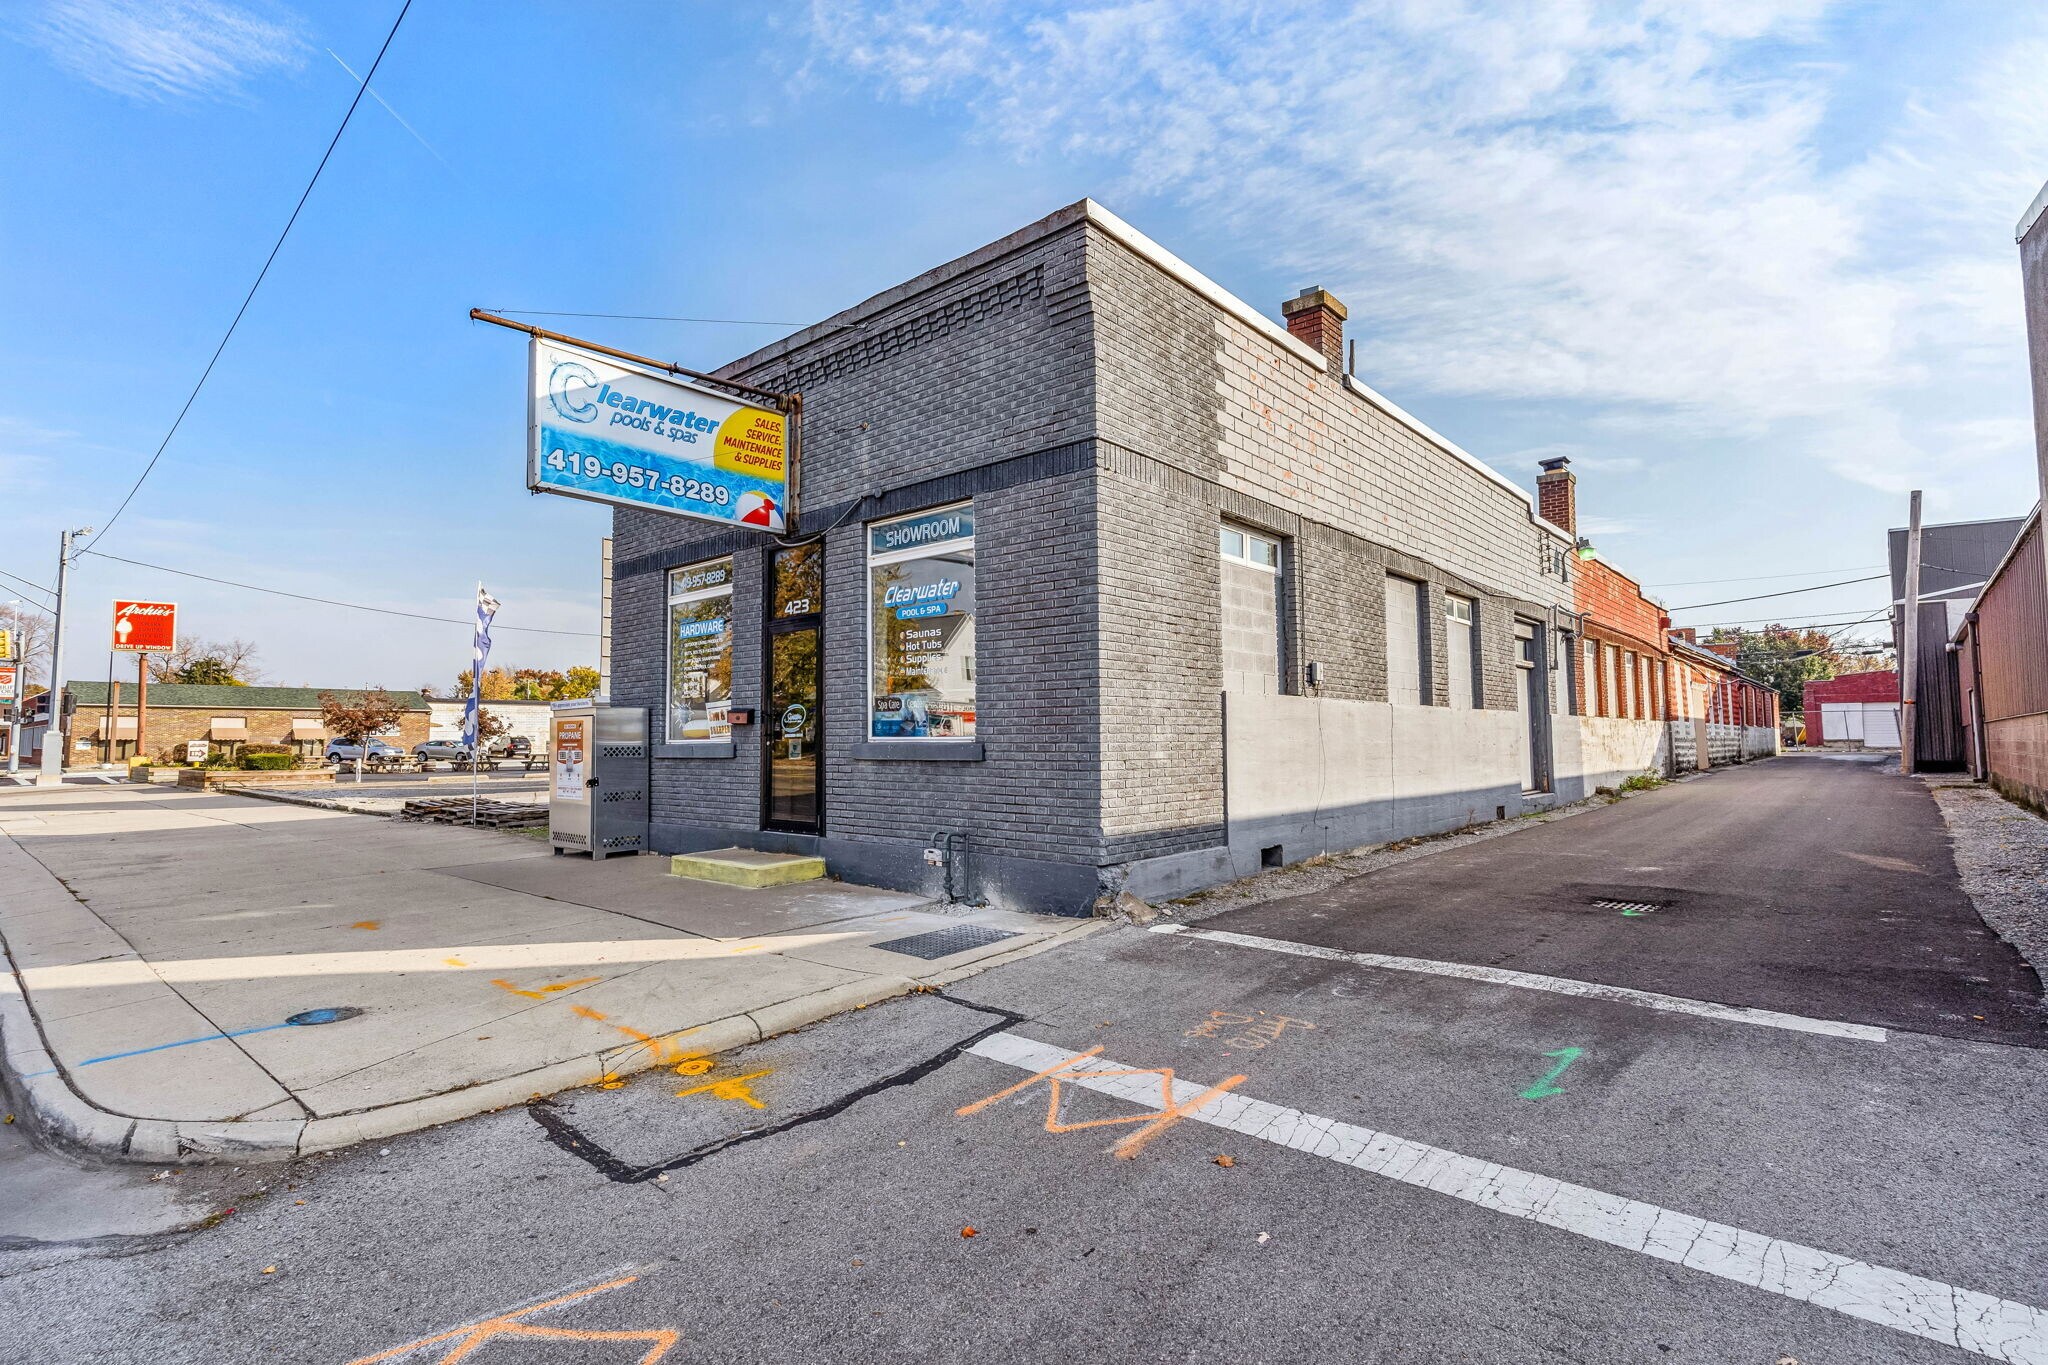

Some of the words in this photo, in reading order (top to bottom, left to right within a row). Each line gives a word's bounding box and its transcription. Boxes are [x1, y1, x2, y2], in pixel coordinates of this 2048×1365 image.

[549, 361, 719, 434] Clearwater
[610, 411, 651, 432] pools
[654, 422, 665, 435] &
[667, 425, 698, 444] spas
[723, 436, 783, 458] MAINTENANCE
[734, 452, 742, 463] &
[743, 454, 783, 471] SUPPLIES
[547, 448, 730, 506] 419-957-8289
[886, 516, 960, 548] SHOWROOM
[884, 578, 959, 604] Clearwater
[784, 598, 810, 615] 423
[902, 608, 919, 617] POOL
[920, 607, 926, 616] &
[927, 606, 941, 615] SPA
[680, 620, 723, 637] HARDWARE
[906, 628, 942, 639] Saunas
[906, 641, 920, 651] Hot
[921, 640, 942, 650] Tubs
[906, 652, 942, 665] Supplies
[877, 700, 888, 711] Spa
[888, 699, 900, 710] Care
[558, 731, 582, 739] PROPANE
